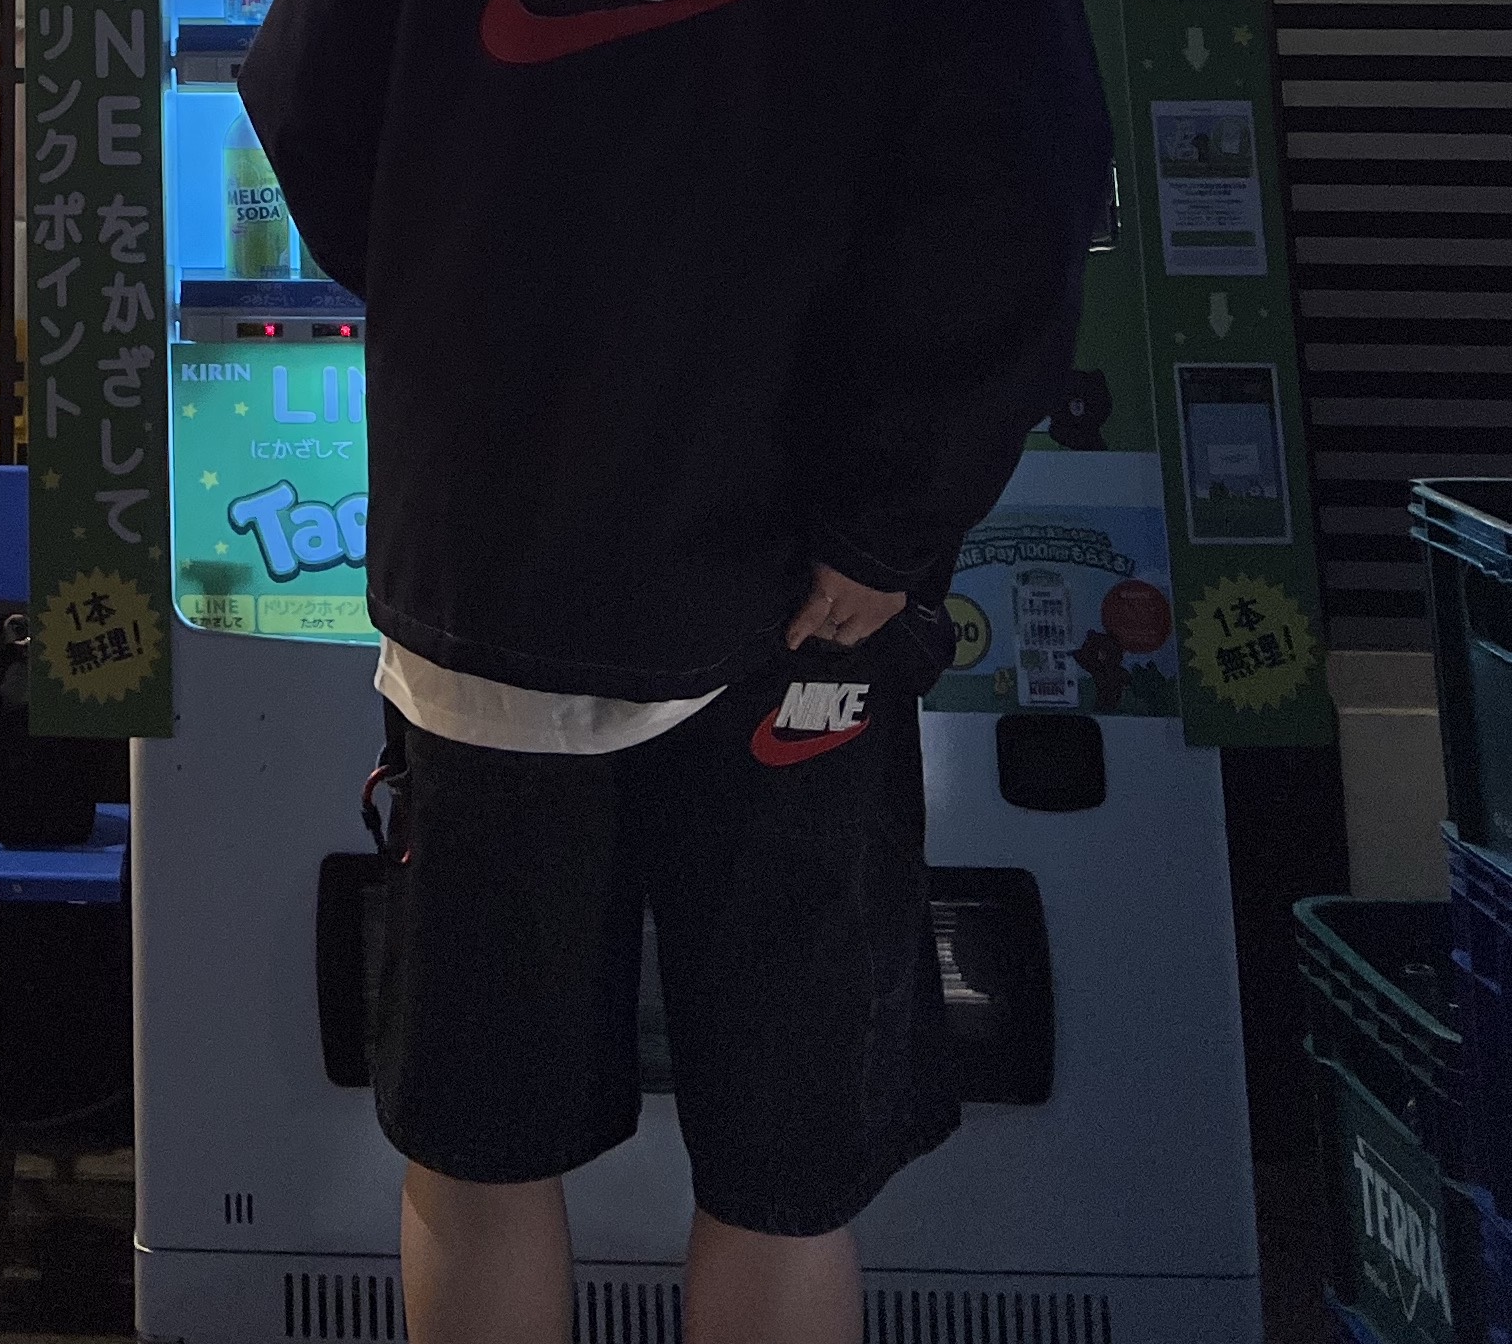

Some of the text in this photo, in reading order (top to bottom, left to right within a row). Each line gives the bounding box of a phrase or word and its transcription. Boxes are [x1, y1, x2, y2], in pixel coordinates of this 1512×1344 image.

[236, 205, 281, 221] SODA
[180, 363, 251, 382] KIRIN
[251, 438, 354, 460] にかざして
[66, 591, 116, 631] 1本
[194, 600, 240, 614] LINE
[1214, 596, 1266, 637] 1本
[772, 681, 871, 732] NIKE
[1352, 1150, 1454, 1327] TERRA
